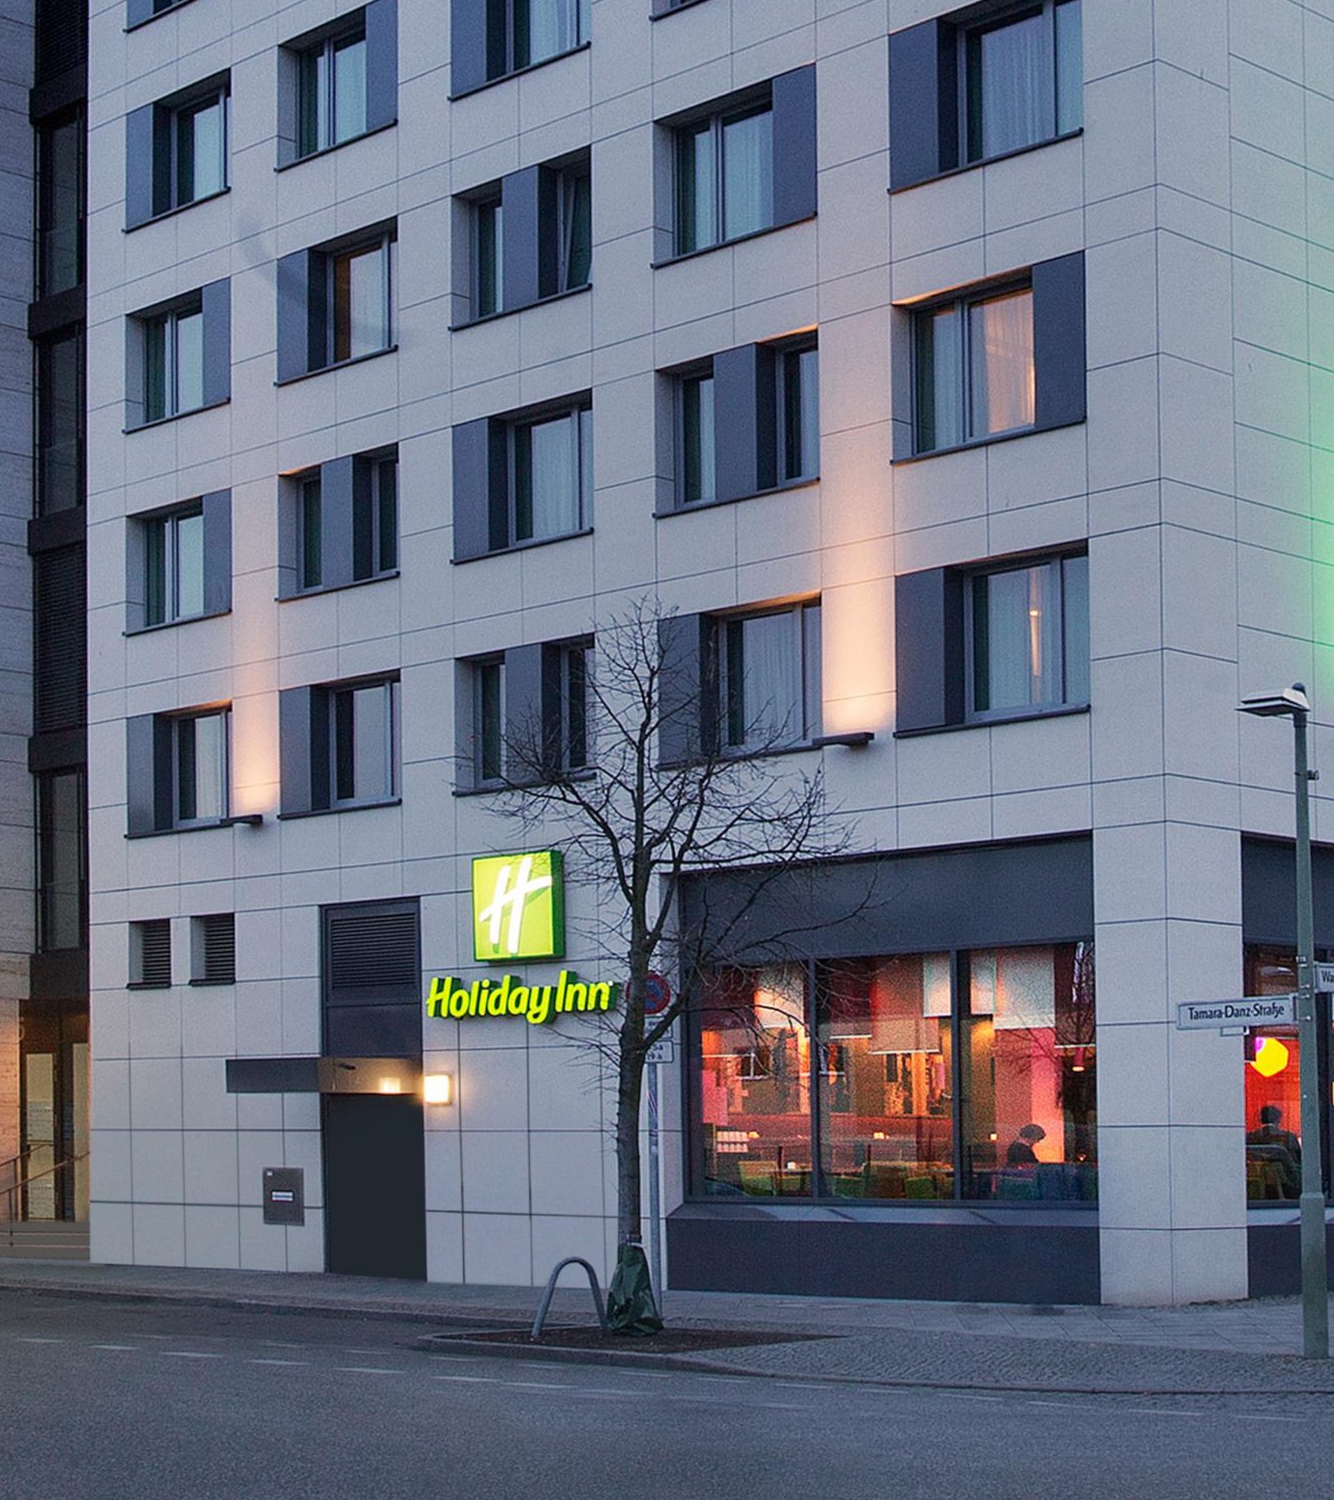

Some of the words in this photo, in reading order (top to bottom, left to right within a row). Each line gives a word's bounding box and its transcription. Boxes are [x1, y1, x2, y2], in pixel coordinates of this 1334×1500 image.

[426, 974, 551, 1024] Holiday
[555, 970, 610, 1012] Inn
[1187, 1003, 1285, 1021] Tamara-Danz-Straße
